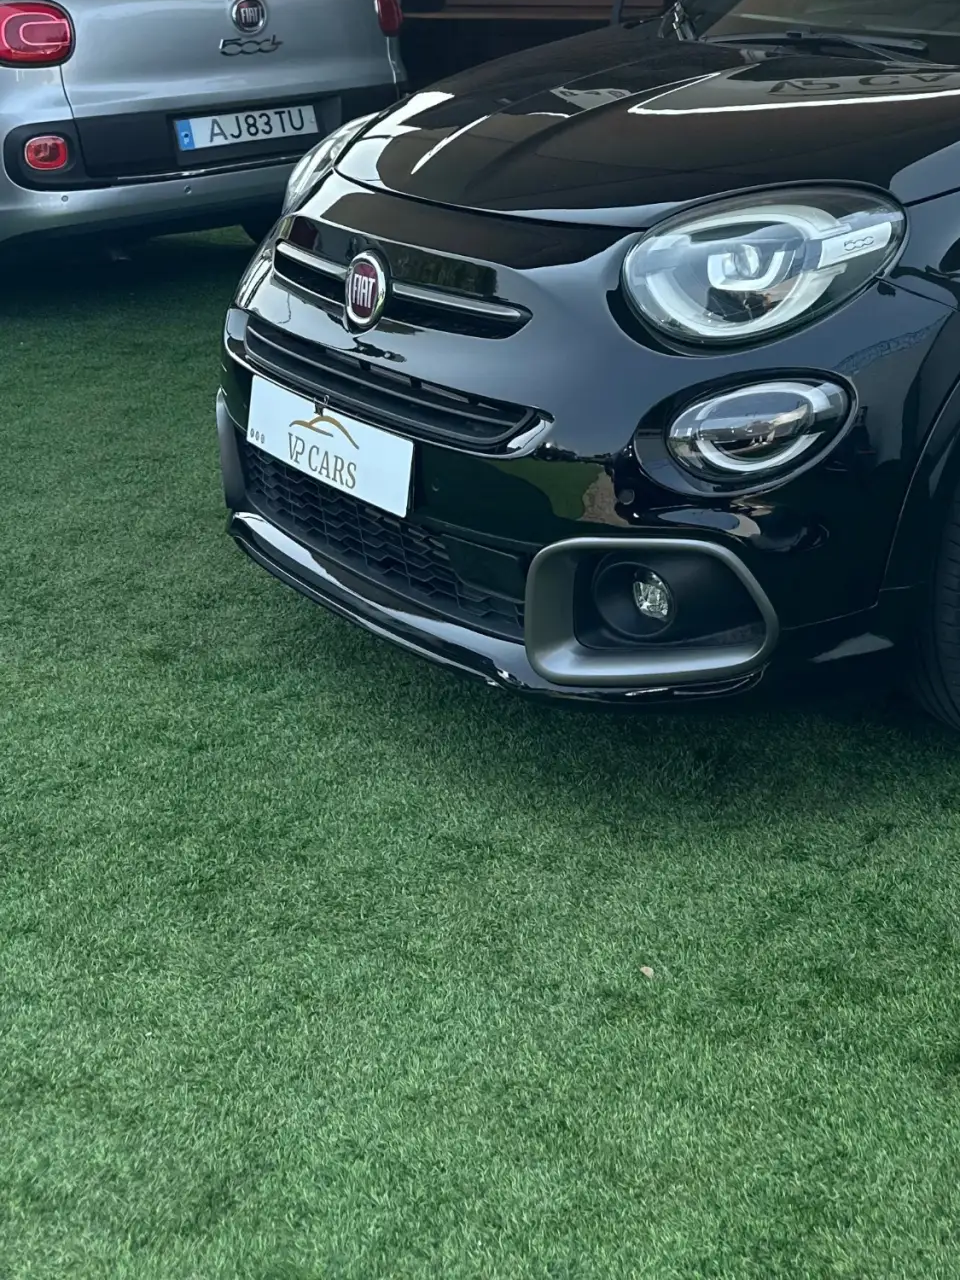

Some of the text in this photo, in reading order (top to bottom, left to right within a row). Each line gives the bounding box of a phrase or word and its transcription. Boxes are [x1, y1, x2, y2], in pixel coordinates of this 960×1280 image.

[240, 7, 259, 24] FIAT
[843, 236, 876, 252] 500
[352, 273, 376, 309] FIAT
[288, 432, 357, 490] VP CARS
